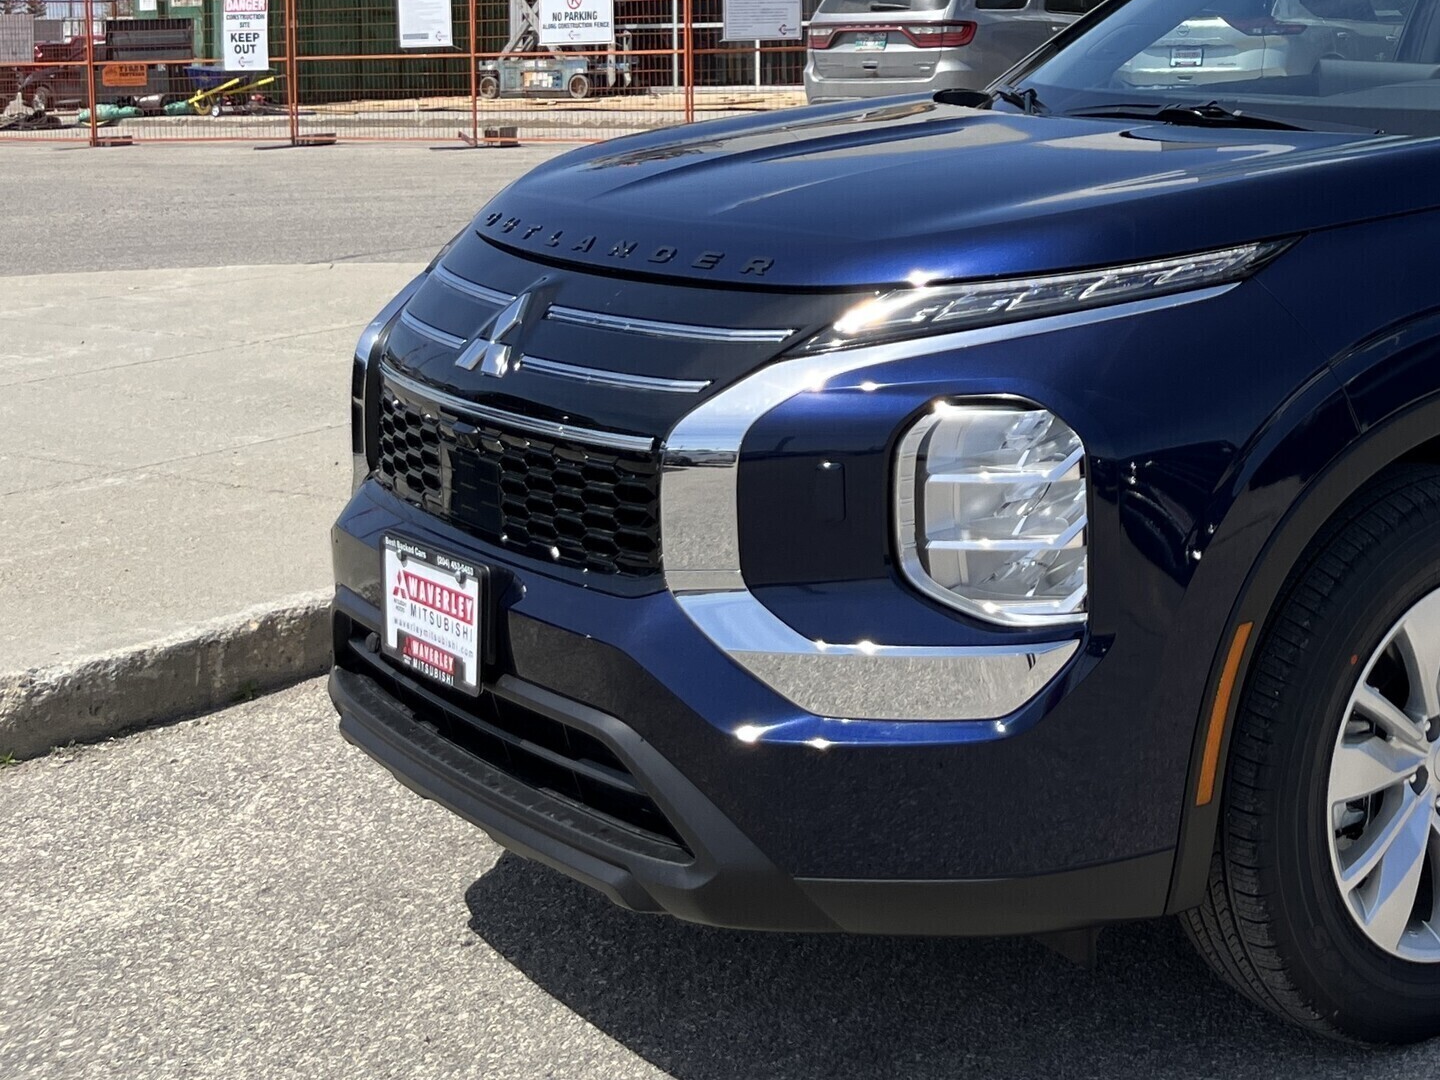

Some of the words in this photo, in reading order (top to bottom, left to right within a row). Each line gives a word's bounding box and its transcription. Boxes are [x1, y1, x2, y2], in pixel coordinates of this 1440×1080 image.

[552, 12, 562, 22] NO
[564, 10, 598, 21] PARKING
[230, 32, 260, 43] KEEP
[234, 44, 256, 54] OUT
[485, 211, 776, 276] OUTLANDER
[414, 546, 427, 559] Cars
[408, 575, 473, 621] WAVERLEY
[410, 603, 473, 643] MITSUBISHI
[394, 618, 474, 659] waverleymitsubishi.com
[411, 640, 454, 671] WAVERLEY
[412, 657, 454, 686] MITSUBISHI
